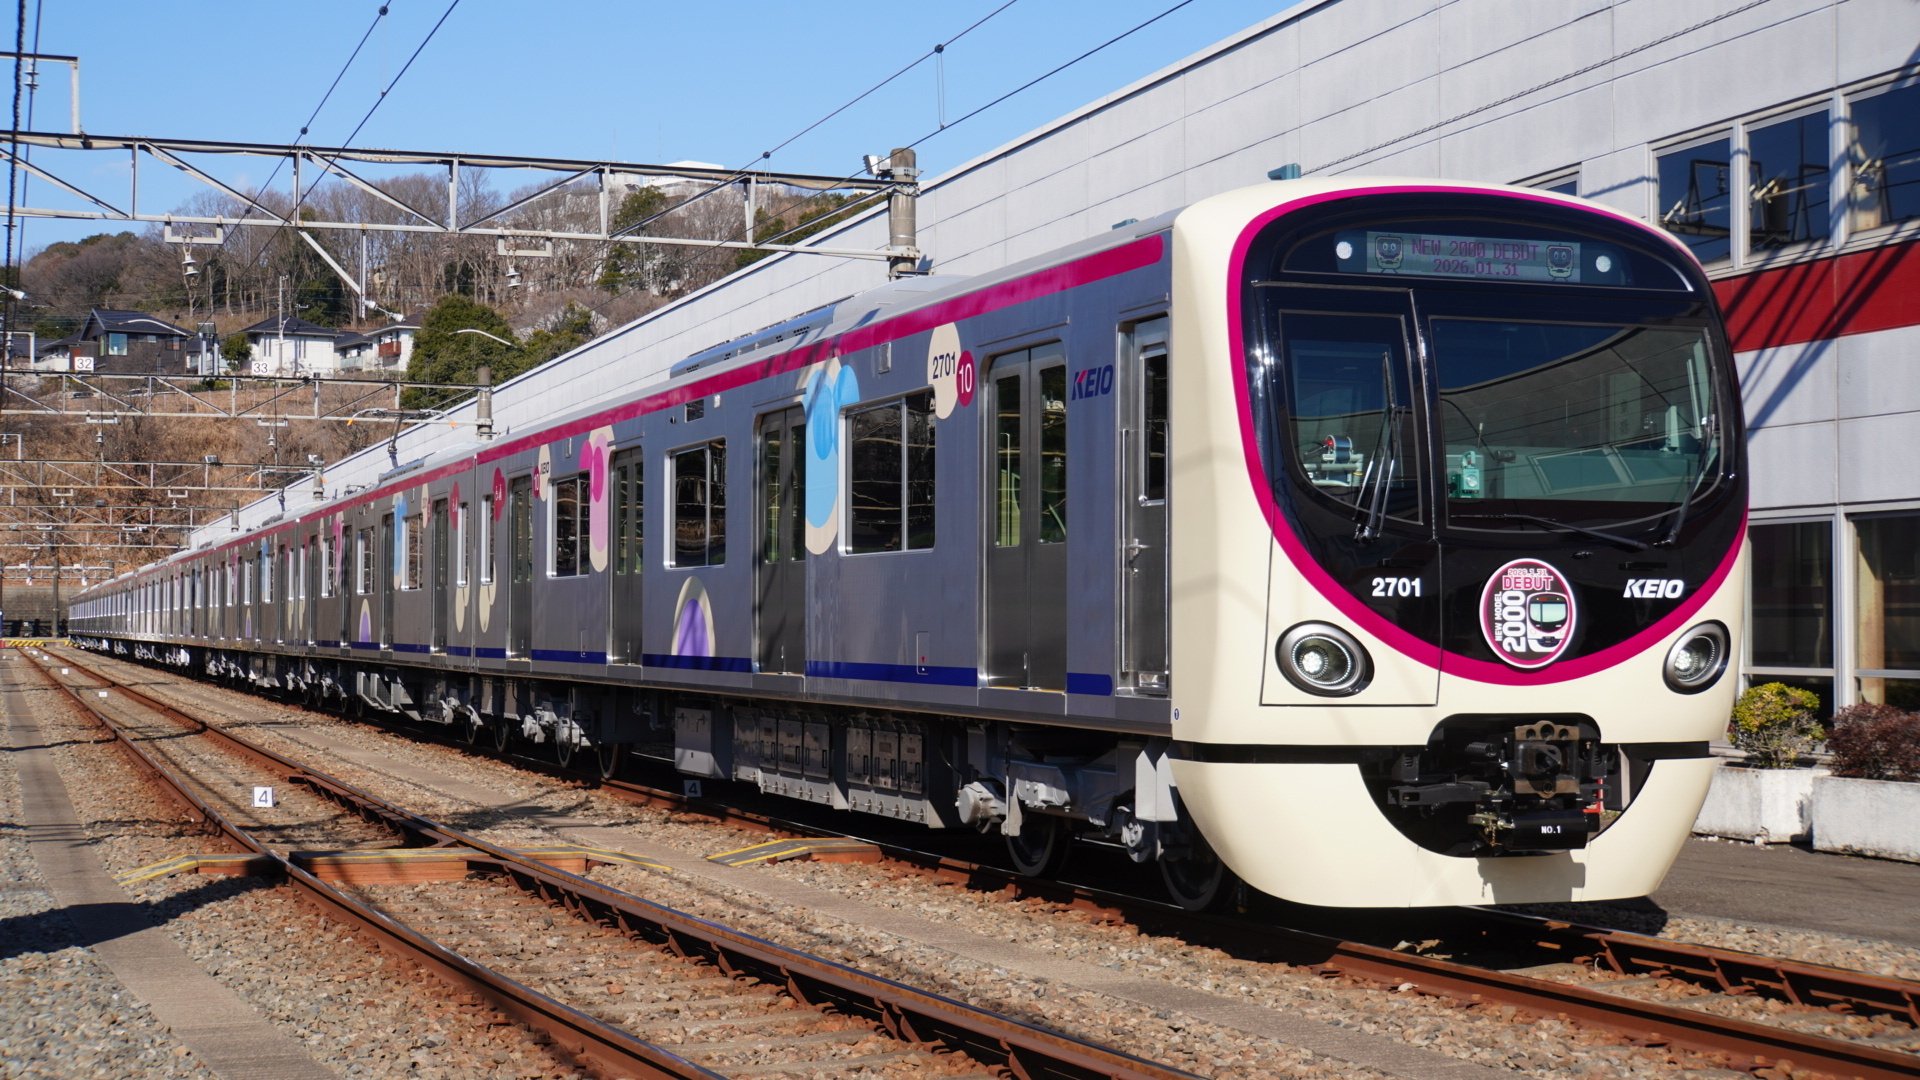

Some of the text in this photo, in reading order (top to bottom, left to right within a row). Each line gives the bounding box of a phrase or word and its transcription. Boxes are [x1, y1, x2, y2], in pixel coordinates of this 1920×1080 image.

[1411, 238, 1539, 261] NEW 2000 DEBUT
[1433, 258, 1520, 277] 2026.01.31
[76, 358, 92, 370] 32
[253, 362, 269, 374] 33
[932, 351, 956, 380] 2701
[958, 362, 973, 394] 10
[1071, 364, 1114, 401] KEIO
[1371, 577, 1421, 597] 2701
[1502, 575, 1554, 591] DEBUT
[1623, 579, 1685, 599] KEIO
[1494, 591, 1503, 642] NEW MODEL
[1502, 590, 1527, 653] 2000
[258, 790, 268, 804] 4
[689, 782, 698, 795] 4
[1541, 825, 1561, 834] NO.1
